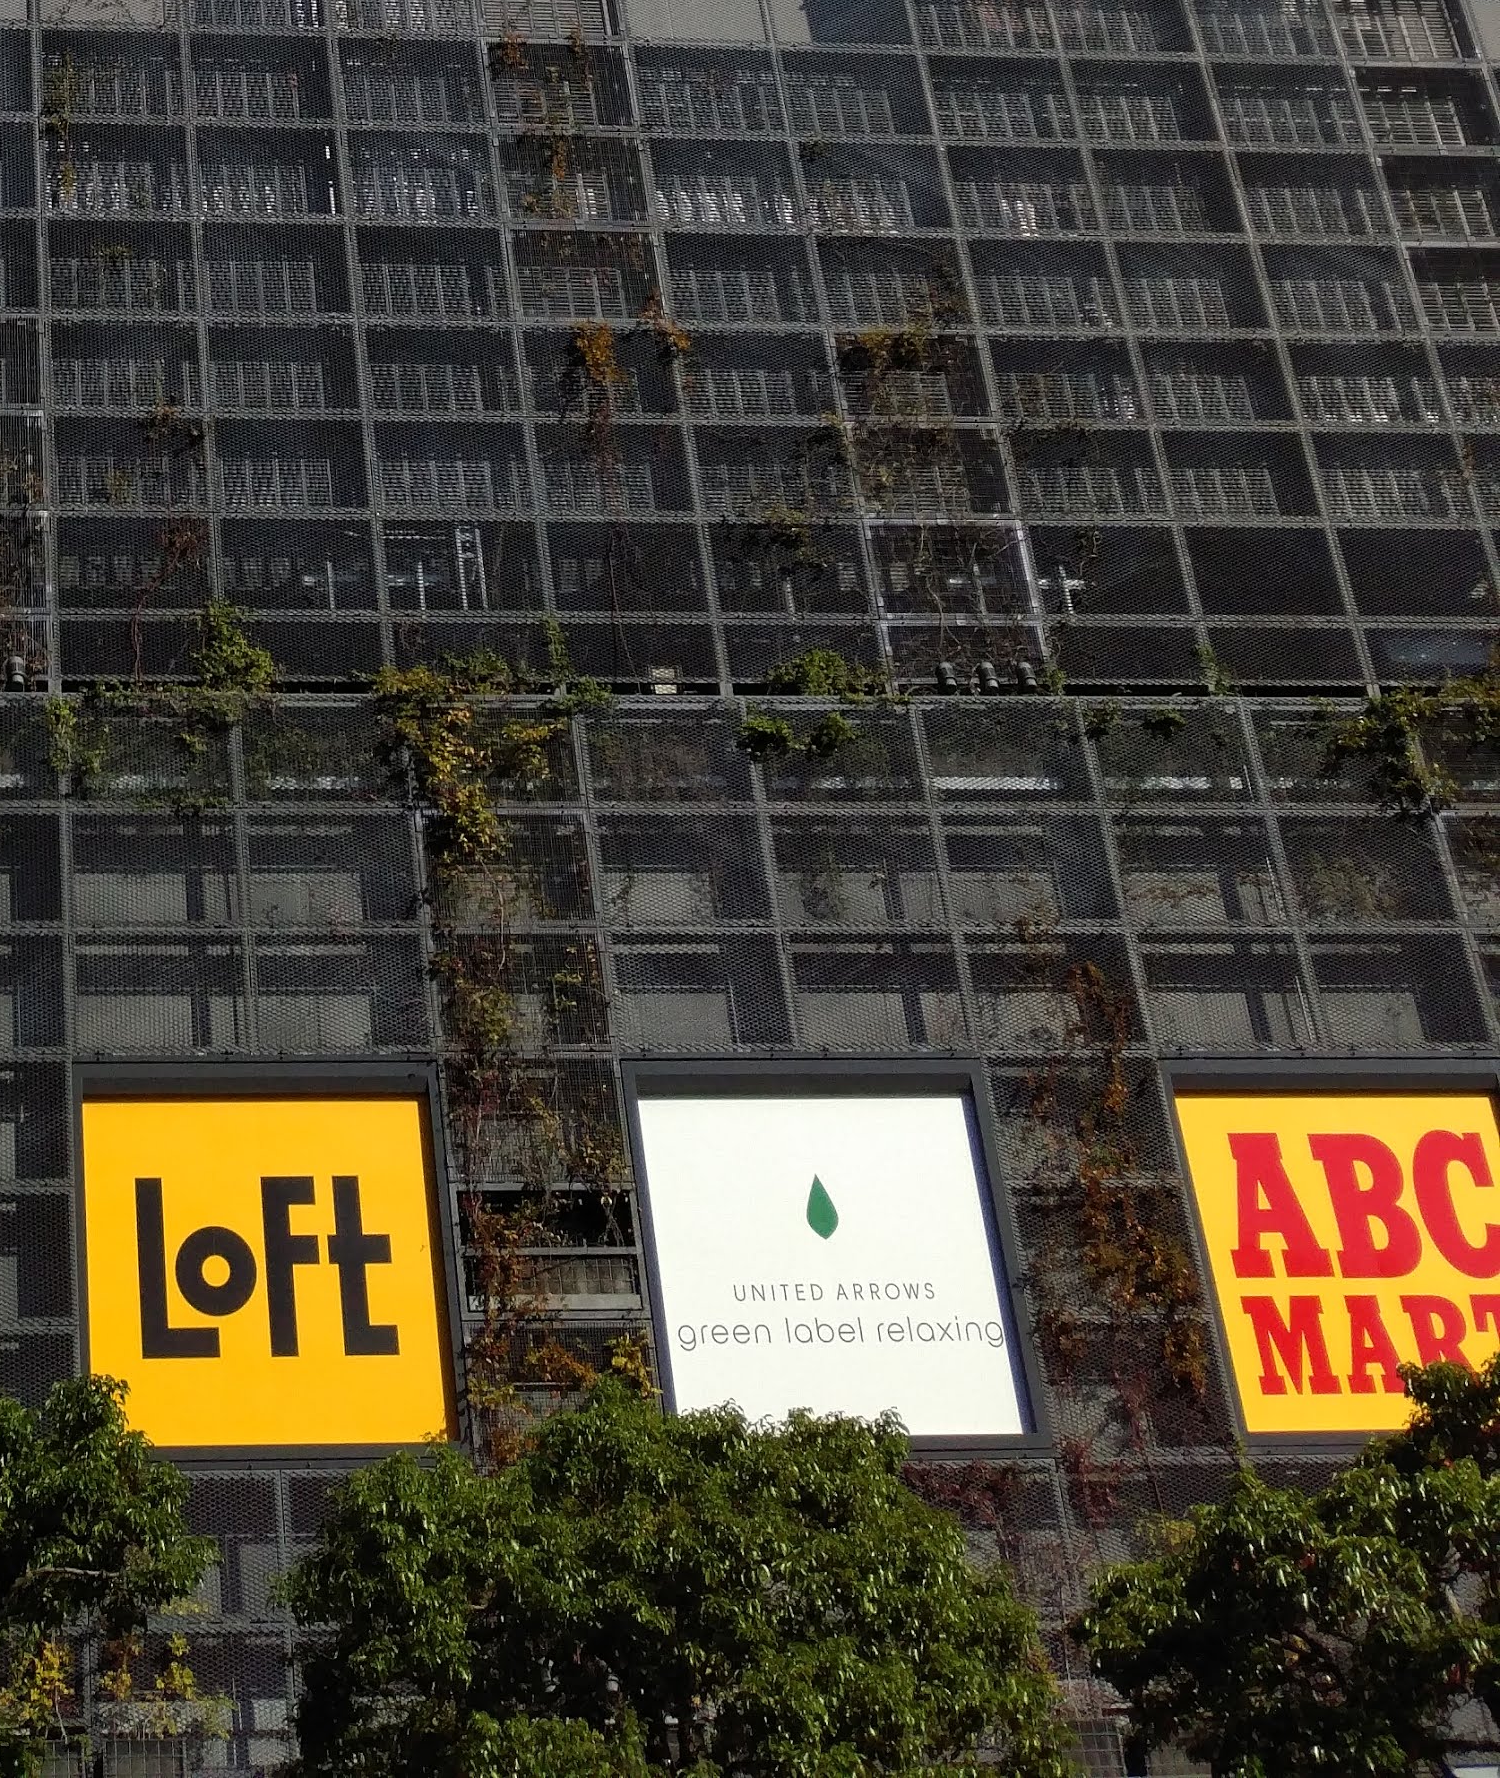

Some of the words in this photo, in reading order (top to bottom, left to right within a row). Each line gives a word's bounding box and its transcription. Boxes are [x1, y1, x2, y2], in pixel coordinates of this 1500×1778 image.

[1227, 1130, 1500, 1279] ABC
[733, 1283, 823, 1302] UNITED
[836, 1283, 936, 1301] ARROWS
[677, 1323, 772, 1352] green
[785, 1317, 864, 1344] label
[876, 1315, 1005, 1348] relaxing
